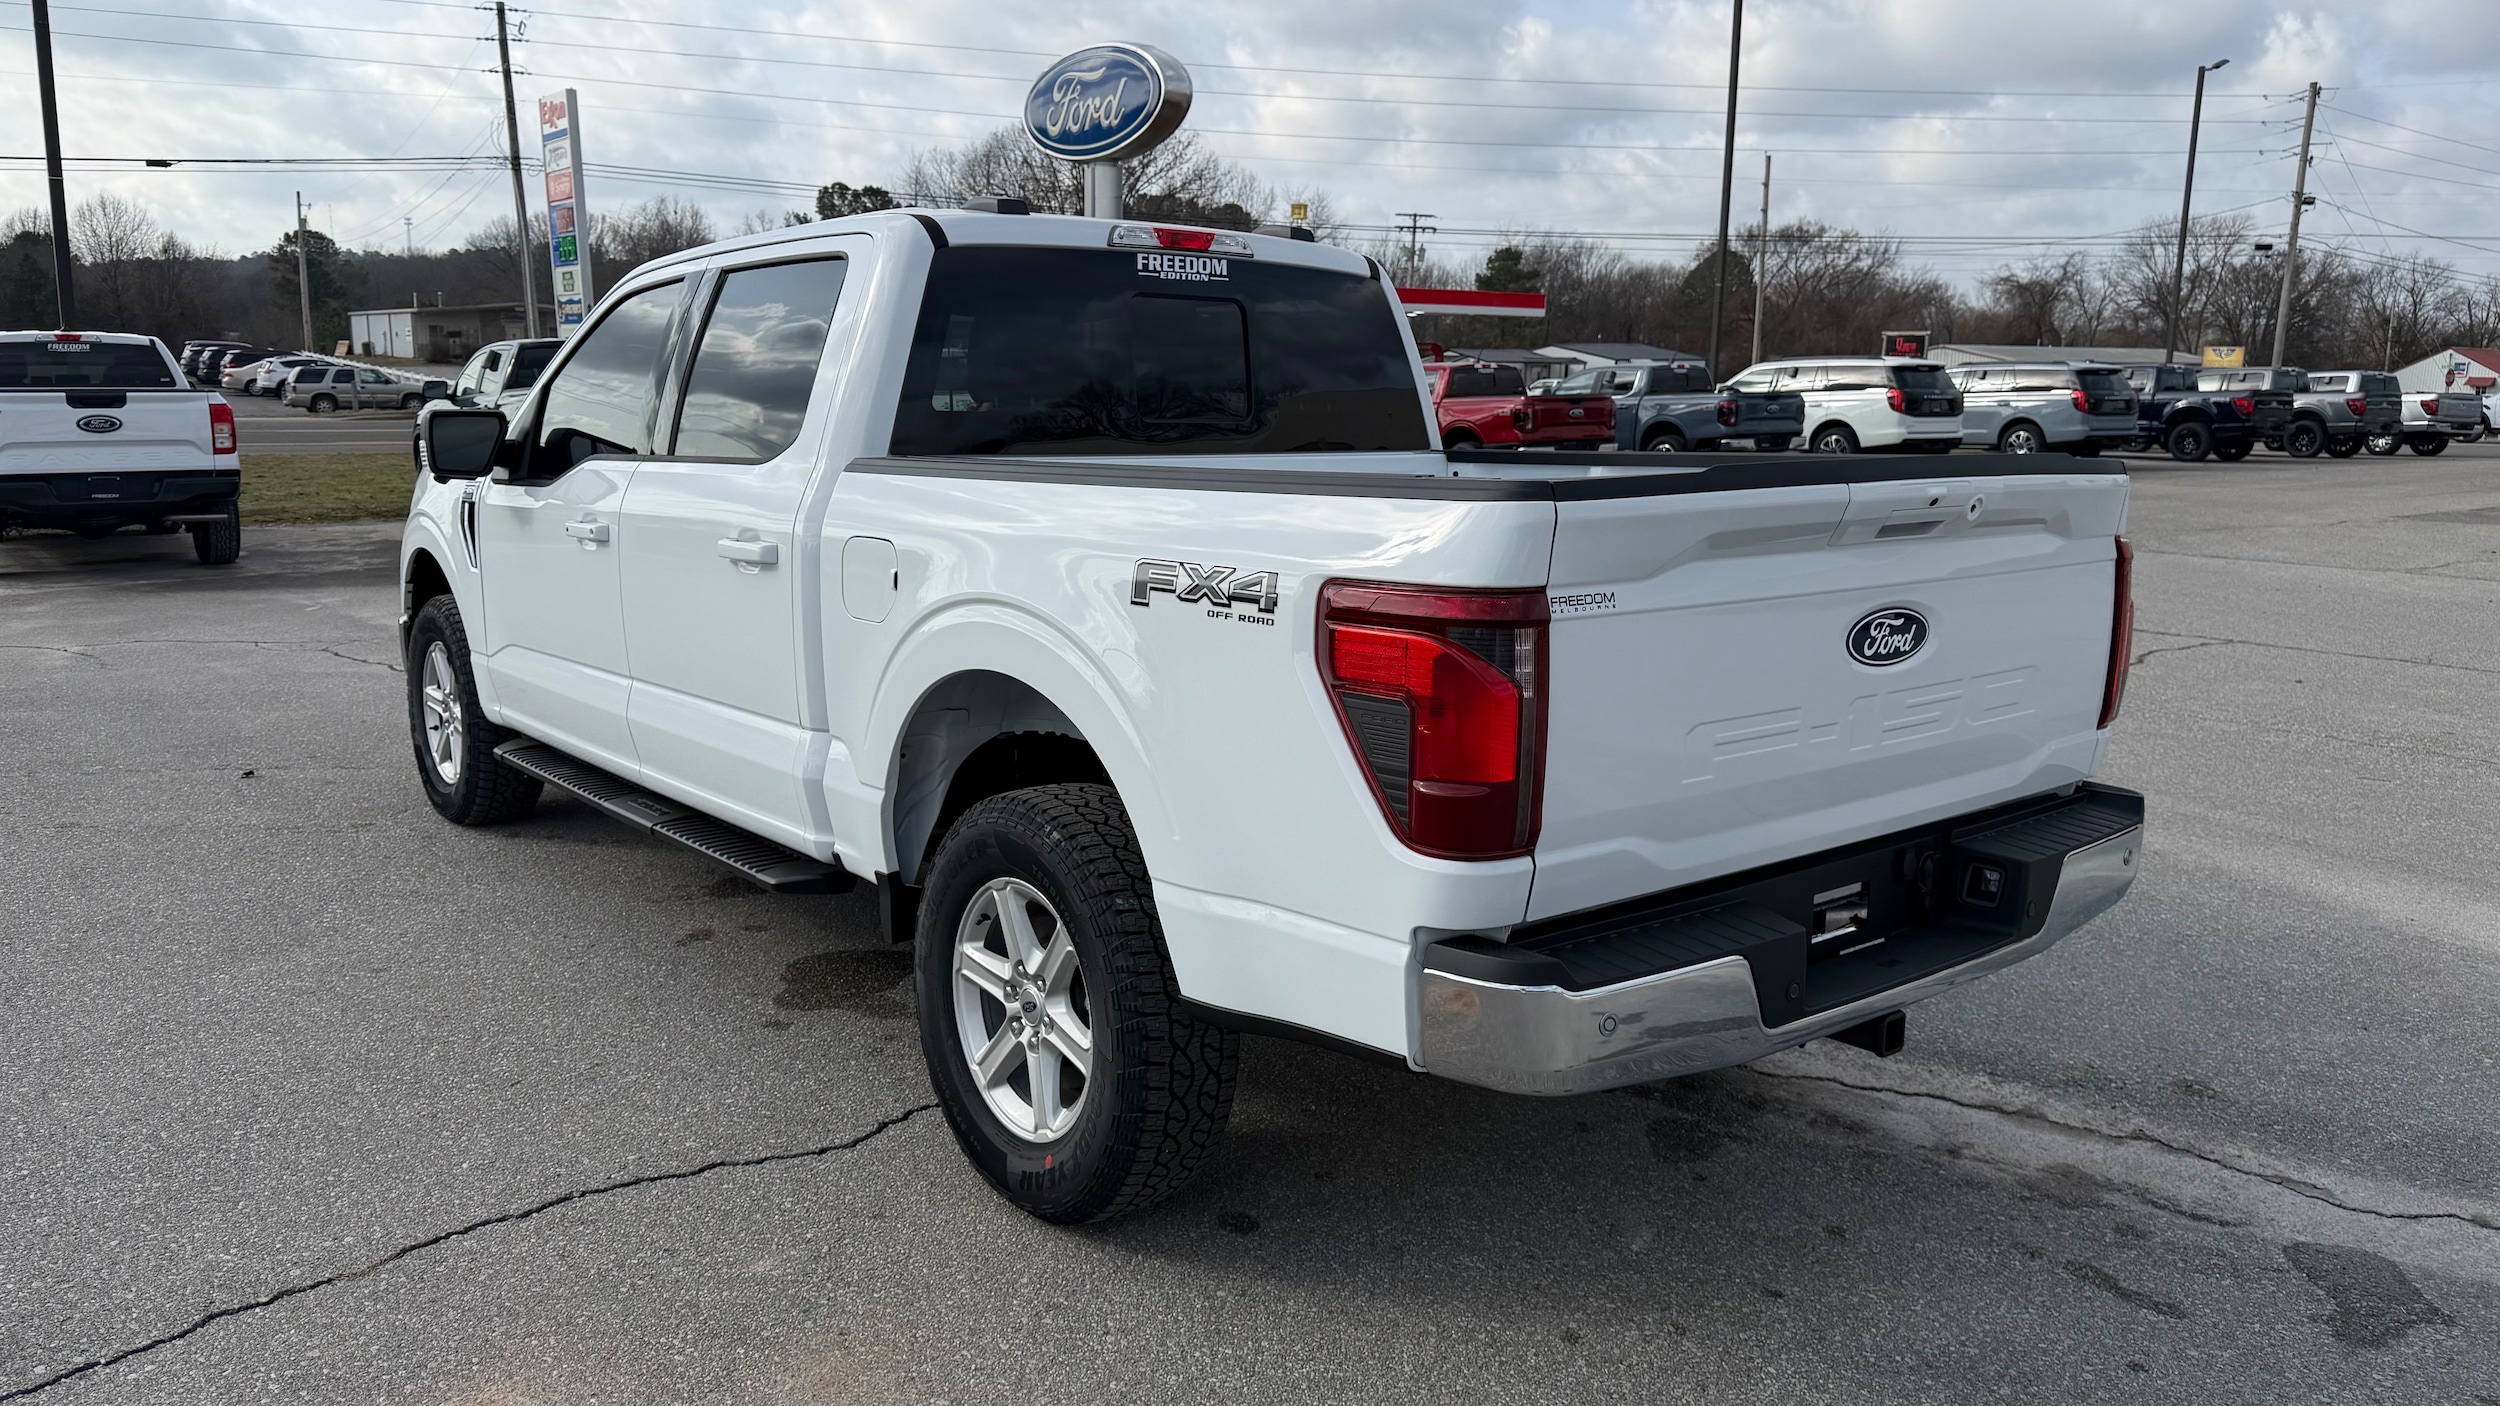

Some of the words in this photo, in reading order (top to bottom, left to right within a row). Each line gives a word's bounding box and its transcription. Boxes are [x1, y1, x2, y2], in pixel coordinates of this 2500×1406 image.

[1046, 67, 1129, 137] Ford
[1137, 253, 1228, 276] FREEDOM
[1159, 271, 1210, 281] EDITION
[89, 419, 111, 429] Ford
[1130, 557, 1280, 614] FX4
[1550, 592, 1616, 608] FREEDOM
[1551, 604, 1617, 614] MELBOURNE
[1207, 610, 1233, 620] OFF
[1238, 614, 1275, 627] ROAD
[1863, 617, 1915, 657] Ford
[1360, 713, 1407, 726] FORD
